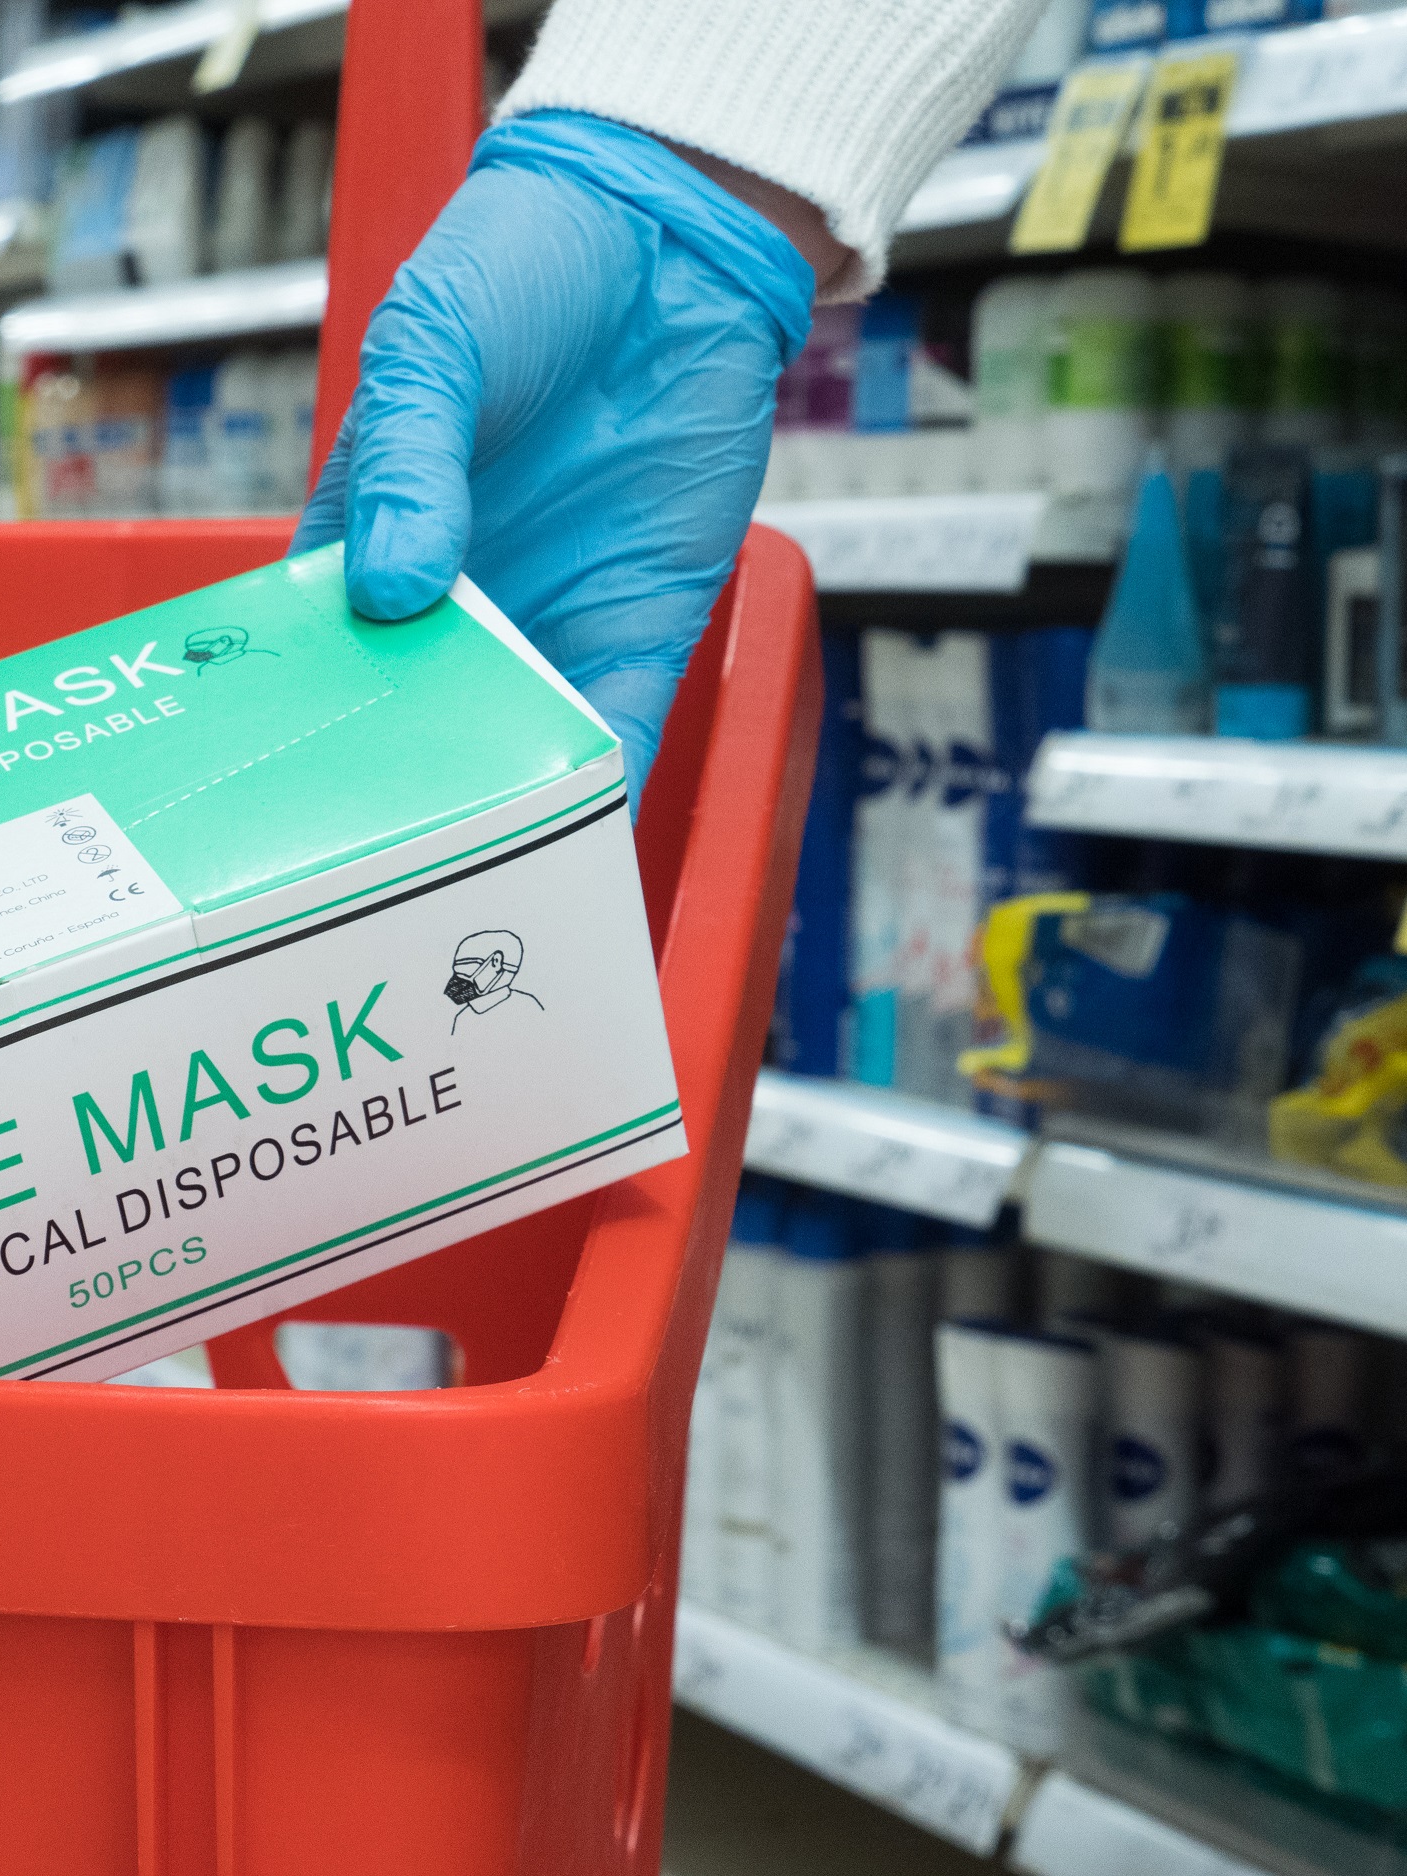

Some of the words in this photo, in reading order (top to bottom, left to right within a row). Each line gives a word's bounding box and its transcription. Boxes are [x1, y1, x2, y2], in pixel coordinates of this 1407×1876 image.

[21, 873, 48, 887] LTD
[27, 888, 66, 905] China
[3, 934, 54, 956] Coruña
[66, 911, 119, 933] España
[73, 980, 404, 1175] MASK
[117, 1066, 462, 1233] DISPOSABLE
[68, 1235, 208, 1310] 50PCS
